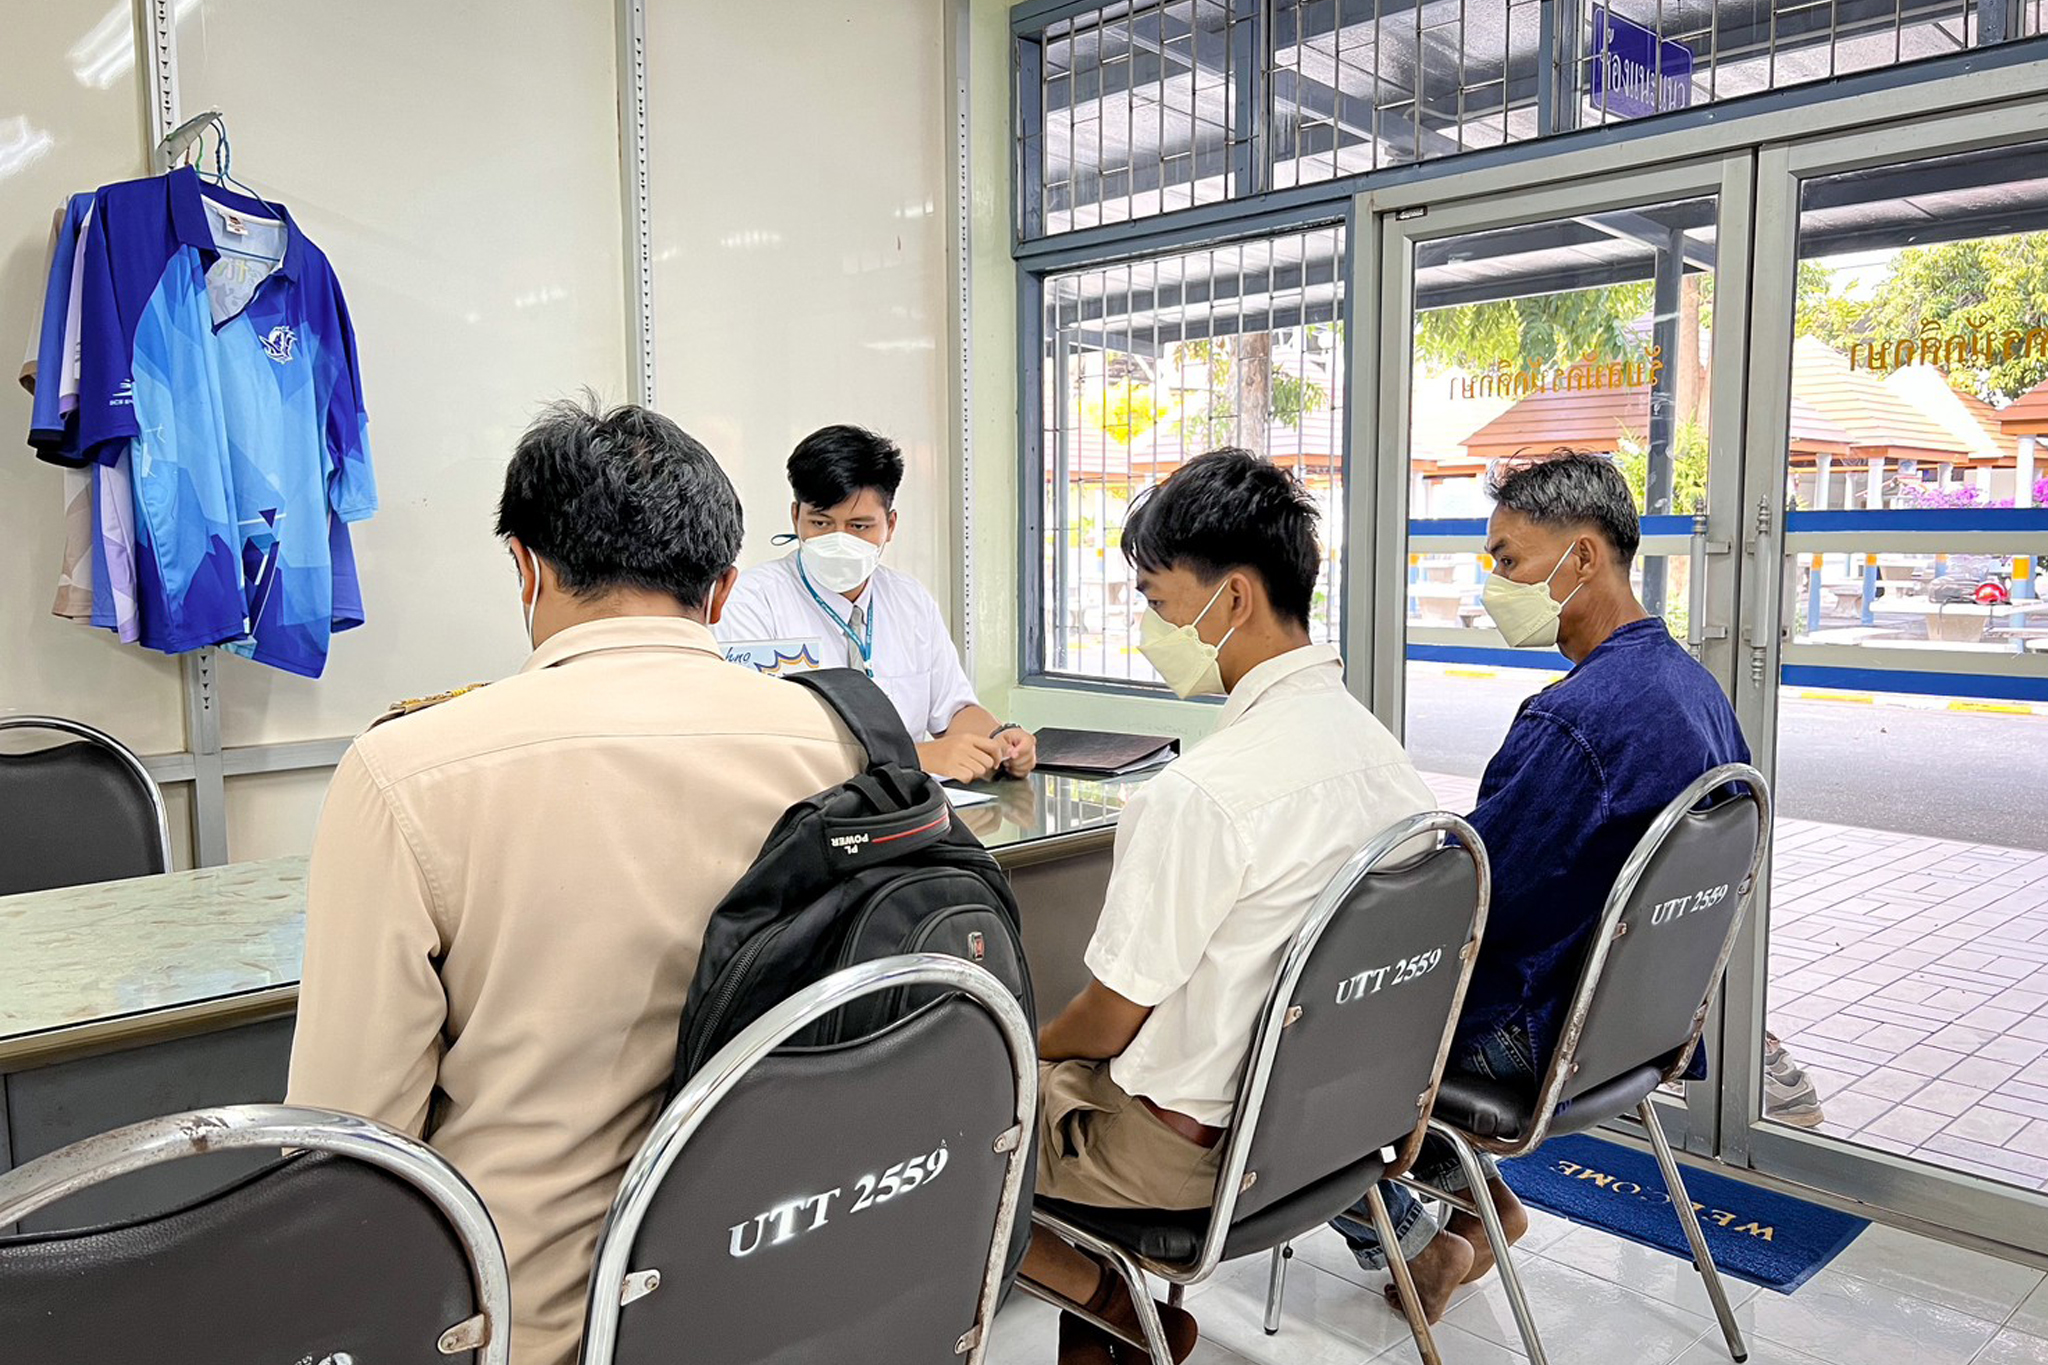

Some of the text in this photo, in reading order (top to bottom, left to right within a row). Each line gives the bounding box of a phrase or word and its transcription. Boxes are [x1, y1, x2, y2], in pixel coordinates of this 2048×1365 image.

[831, 832, 869, 847] POWER
[844, 844, 859, 855] PL
[1651, 884, 1728, 925] UTT 2559
[1336, 948, 1442, 1004] UTT 2559
[729, 1147, 949, 1257] UTT 2559
